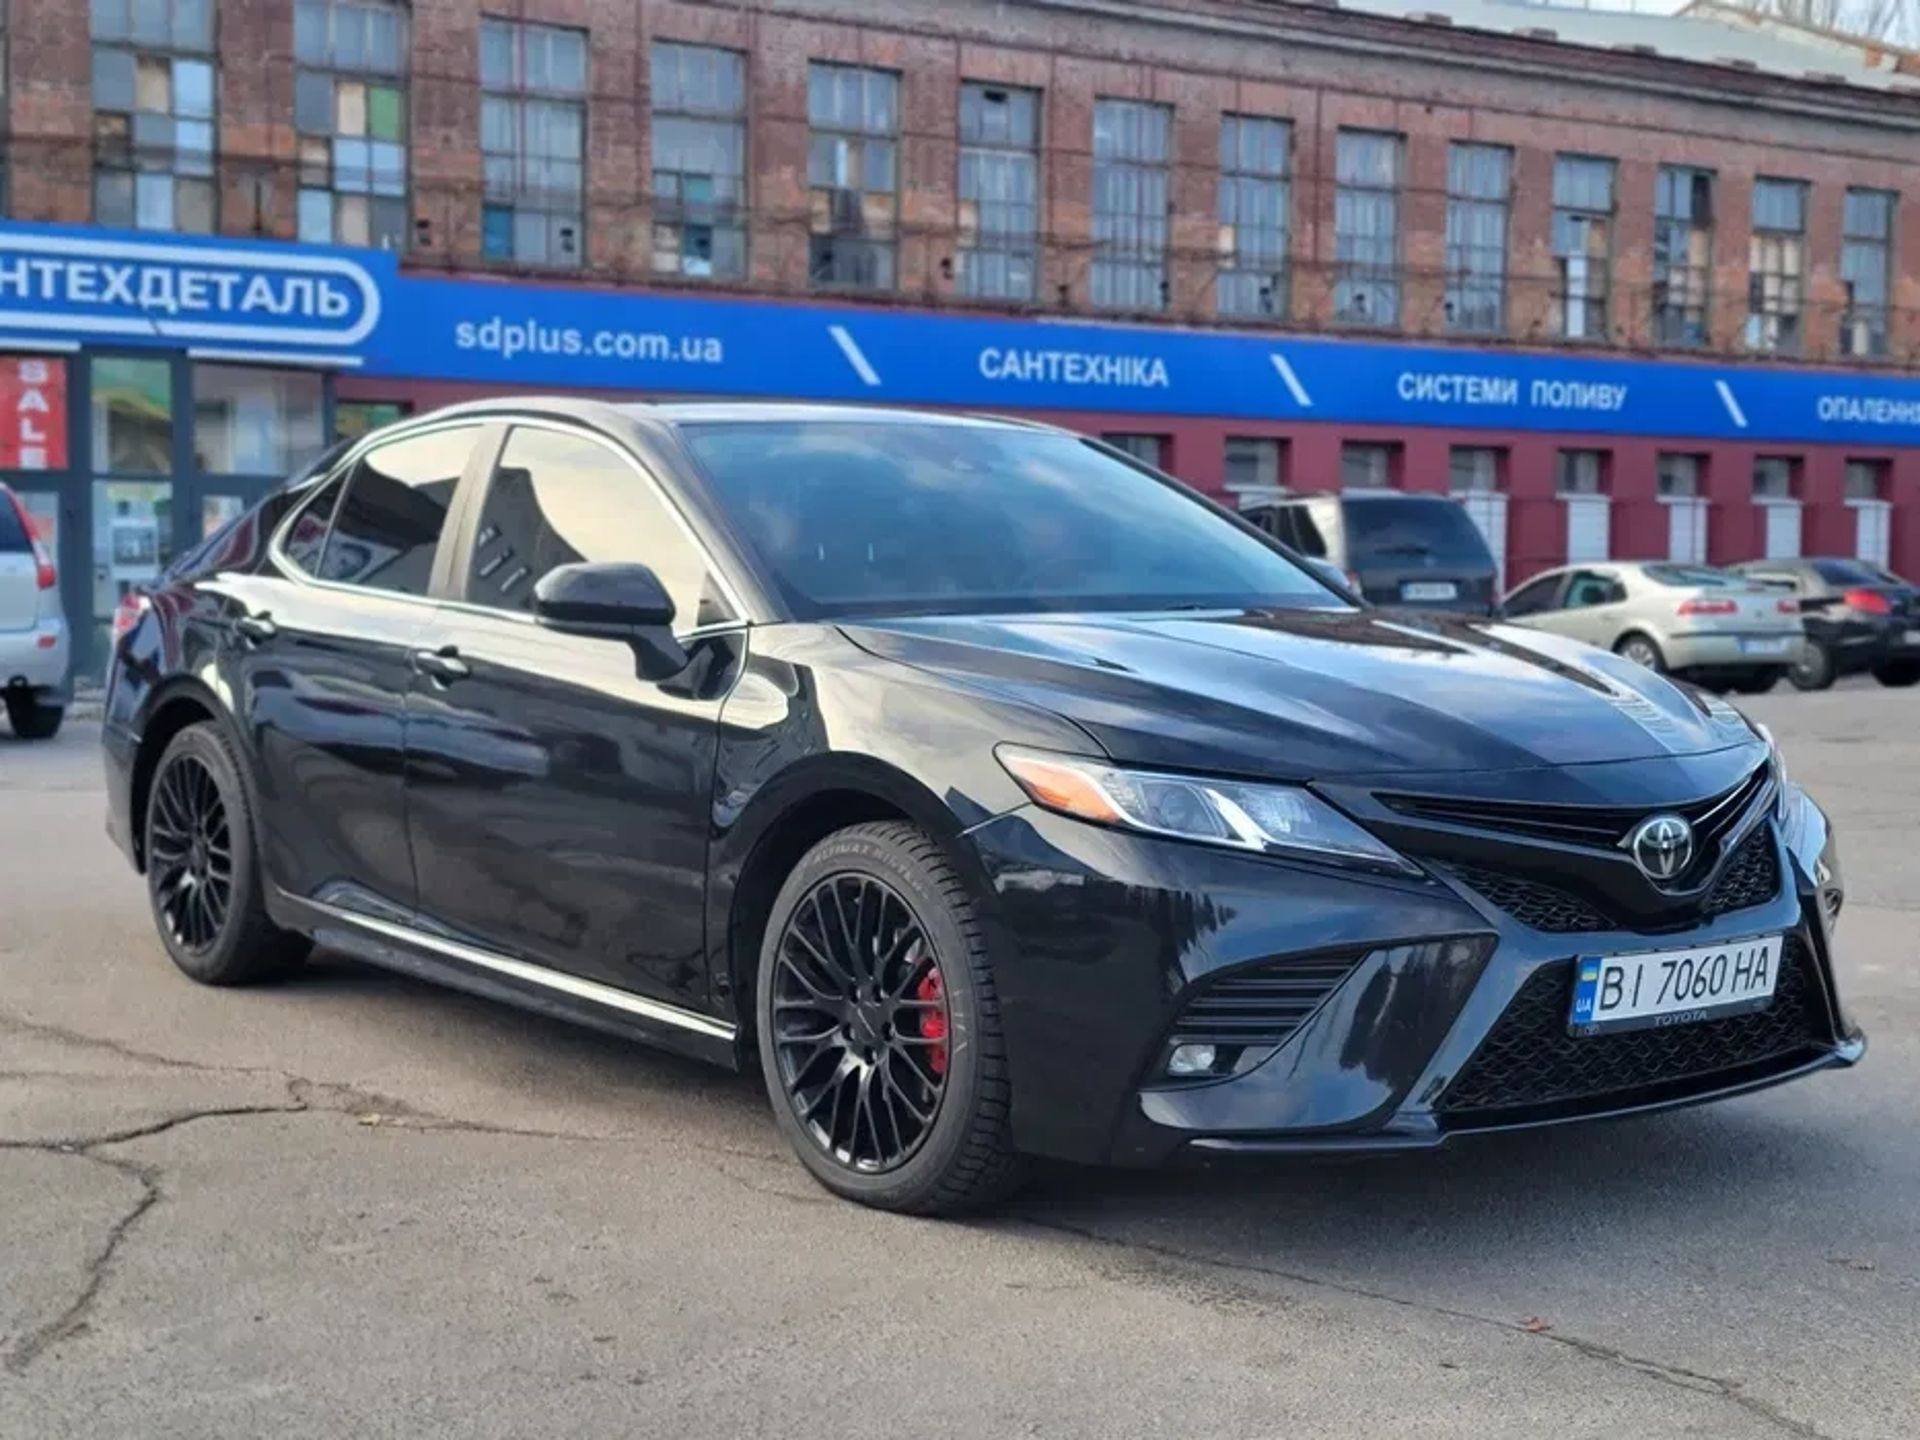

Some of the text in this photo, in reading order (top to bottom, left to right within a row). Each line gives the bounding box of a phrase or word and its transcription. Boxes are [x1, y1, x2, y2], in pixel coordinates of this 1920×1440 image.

[0, 257, 349, 316] НТЕХДЕТАЛЬ
[455, 316, 723, 363] sdplus.com.ua
[979, 348, 1169, 388] САНТЕХНІКА
[1397, 372, 1627, 411] СИСТЕМИ ПОЛИВУ
[19, 360, 48, 470] SALE
[1599, 946, 1769, 1010] BI 7060 HA
[1576, 997, 1592, 1013] UA
[1654, 1010, 1707, 1027] TOYOTA
